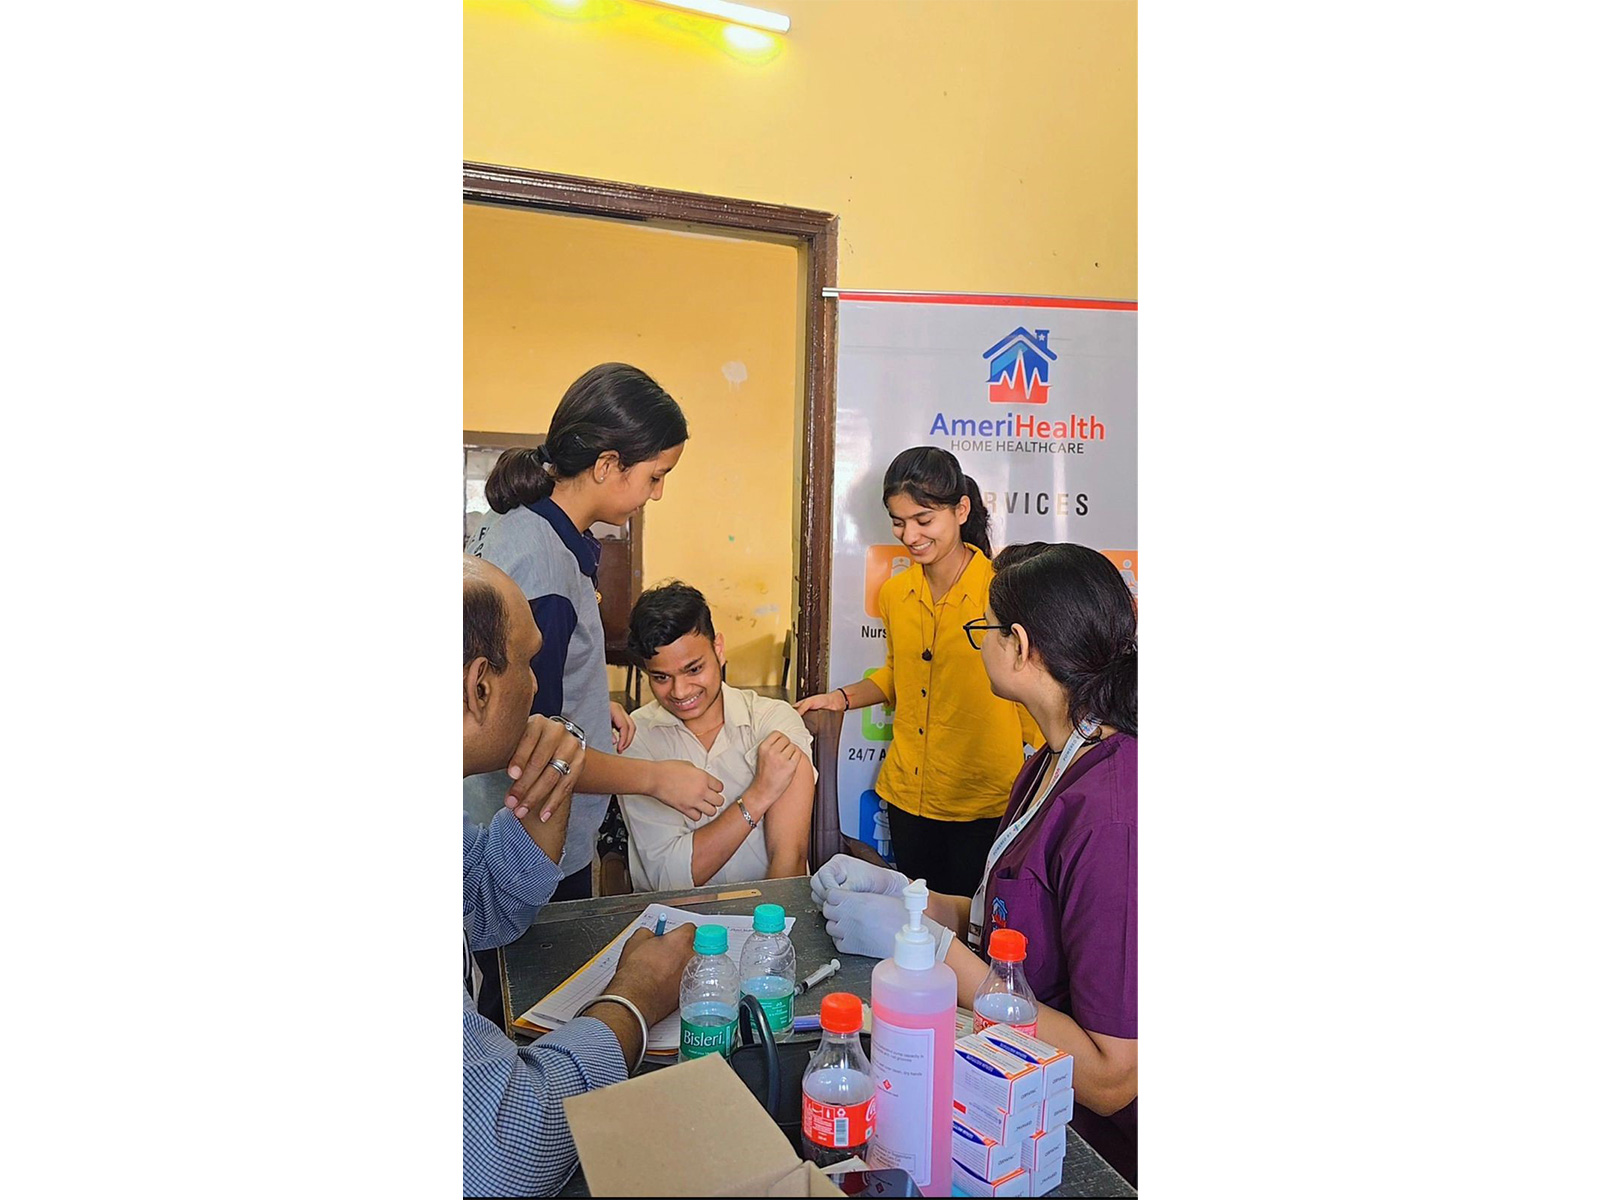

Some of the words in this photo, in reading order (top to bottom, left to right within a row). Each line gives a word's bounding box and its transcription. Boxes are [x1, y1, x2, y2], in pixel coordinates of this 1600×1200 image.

[929, 412, 1106, 440] AmeriHealth
[950, 440, 993, 452] HOME
[996, 441, 1085, 454] HEALTHCARE
[983, 491, 1089, 516] RVICES
[861, 625, 887, 639] Nurs
[848, 747, 876, 762] 24/7
